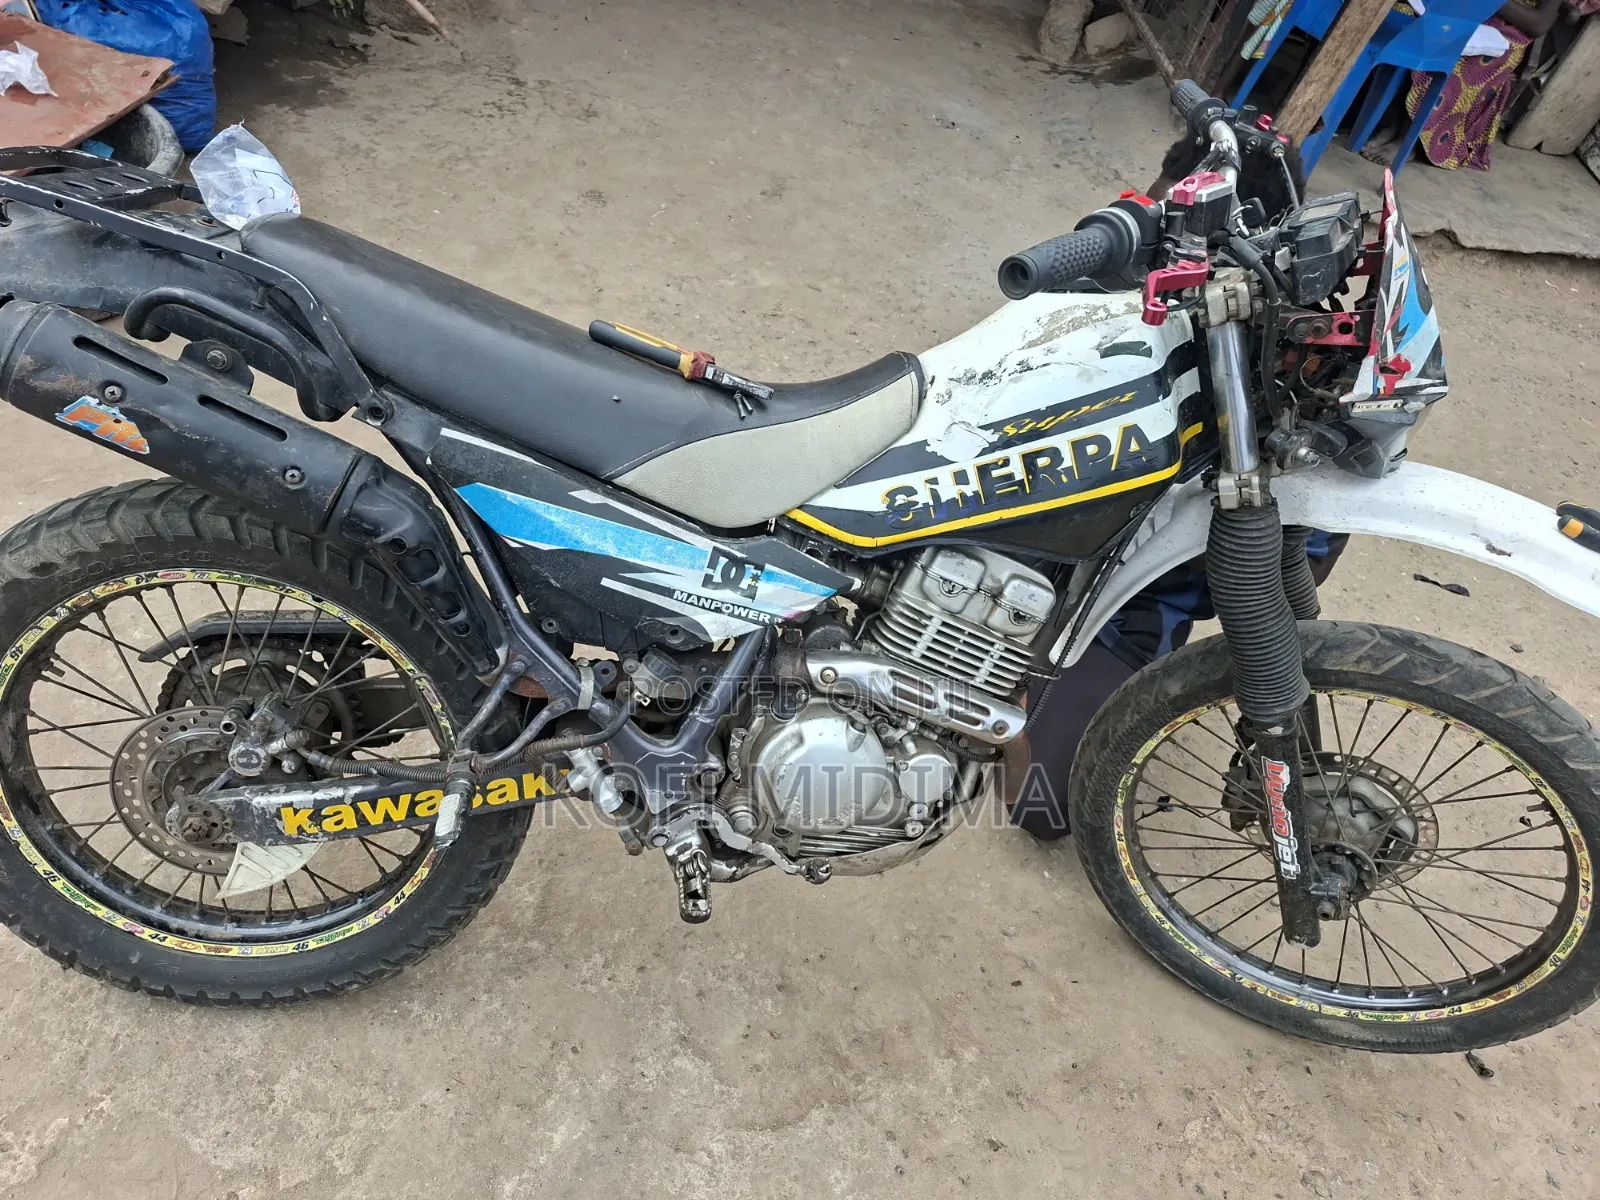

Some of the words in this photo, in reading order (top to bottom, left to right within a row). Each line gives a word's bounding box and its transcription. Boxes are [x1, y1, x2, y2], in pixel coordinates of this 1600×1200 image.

[672, 589, 771, 624] MANPOWER
[41, 868, 61, 883] 46
[393, 889, 407, 906] 44
[147, 932, 169, 943] 44
[291, 941, 310, 952] 46
[1447, 1005, 1463, 1016] 44
